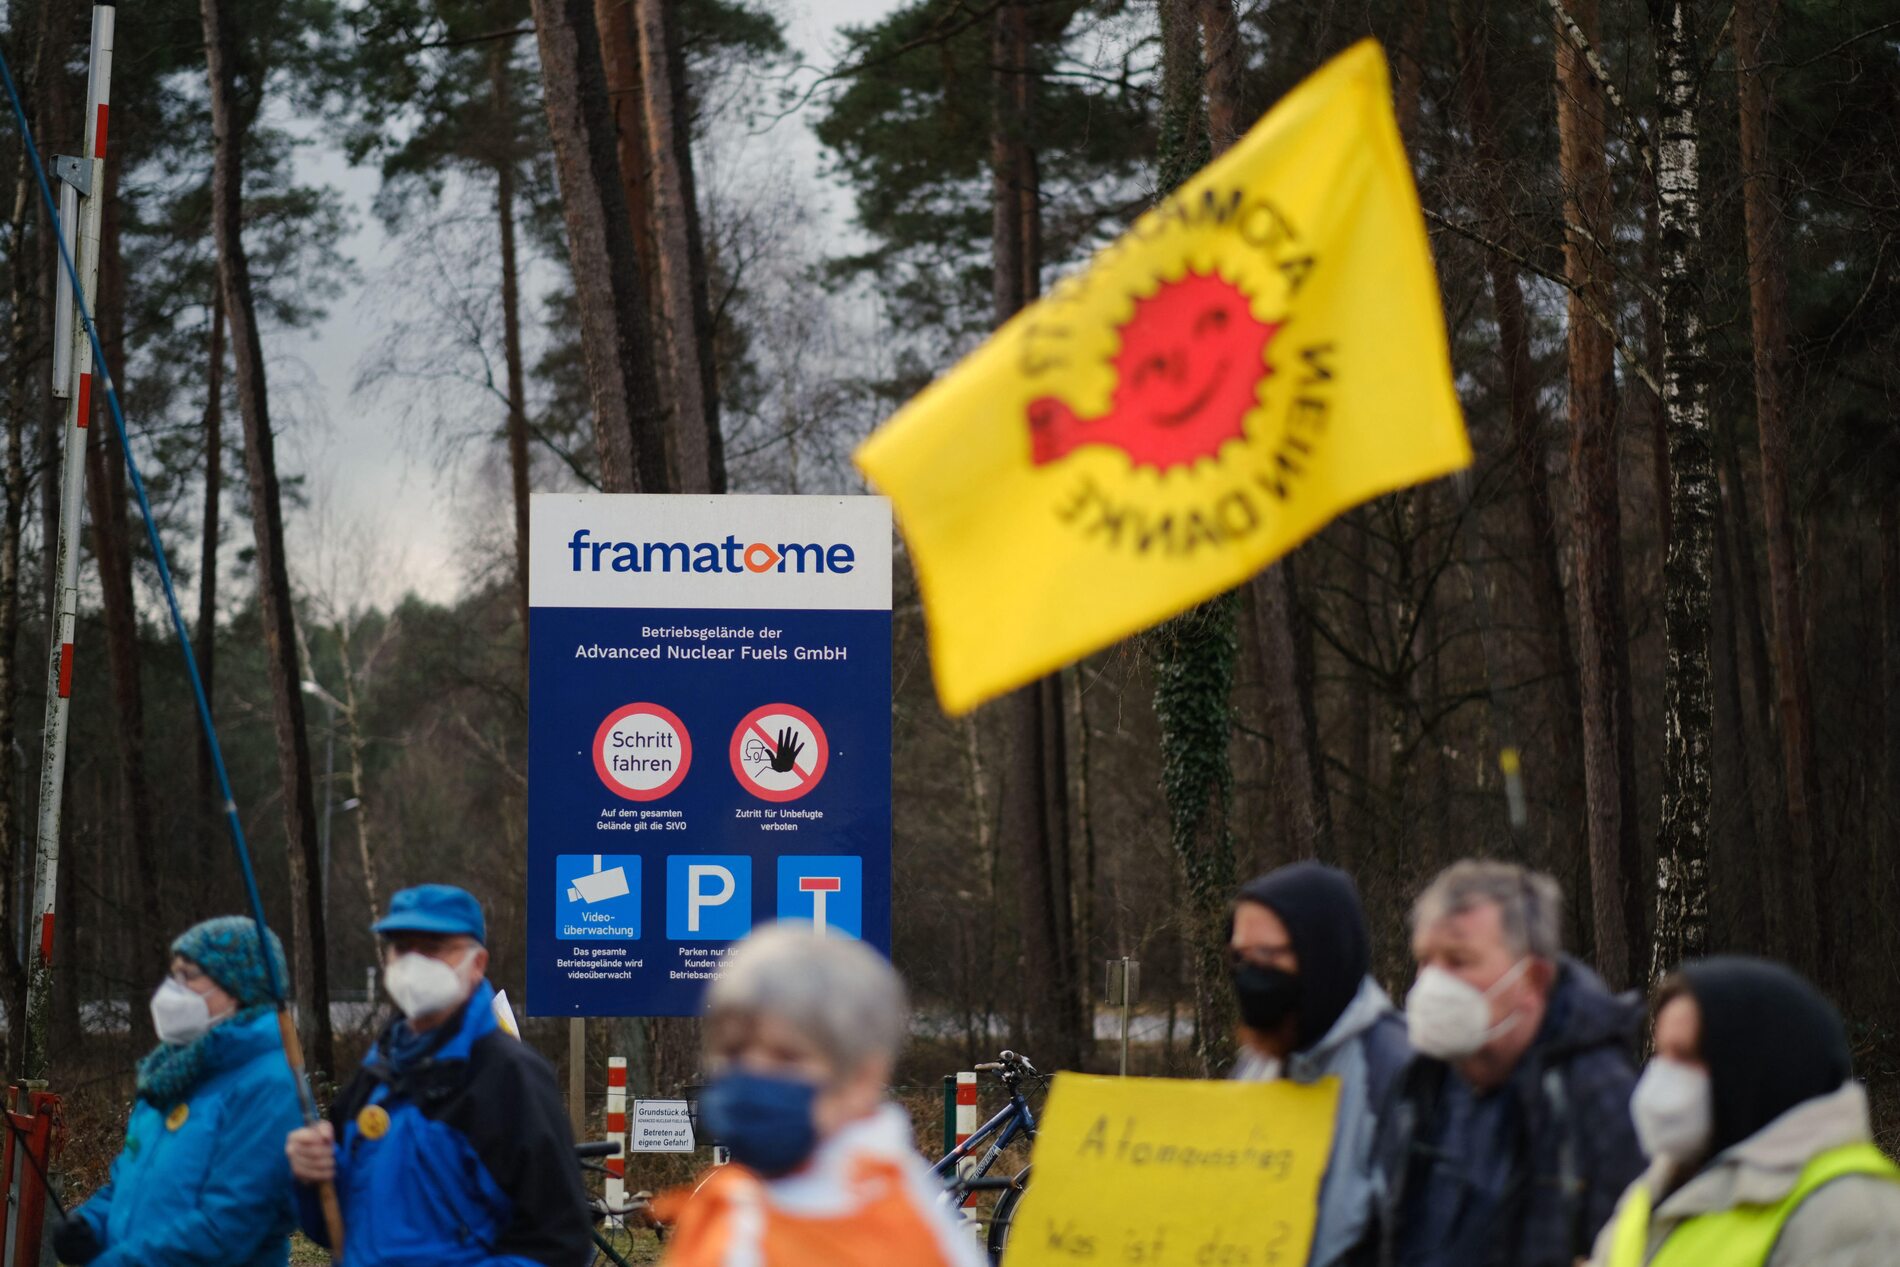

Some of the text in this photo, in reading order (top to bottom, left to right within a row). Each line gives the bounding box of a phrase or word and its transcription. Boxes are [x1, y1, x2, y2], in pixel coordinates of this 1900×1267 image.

[568, 529, 855, 574] framatome
[641, 626, 783, 640] Betriebsgelände der
[575, 644, 848, 660] Advanced Nuclear Fuels GmbH
[612, 731, 673, 748] Schritt
[612, 755, 672, 772] fahren
[601, 808, 683, 819] Auf dem gesamten
[735, 809, 823, 820] Zutritt für Unbefugte
[596, 821, 687, 832] Gelände gilt die StVO
[760, 822, 798, 831] verboten
[688, 865, 735, 931] P
[581, 912, 615, 922] Video-
[563, 925, 634, 937] überwachung
[573, 947, 627, 957] Das gesamte
[679, 947, 708, 956] Parken
[557, 959, 643, 969] Betriebsgelände wird
[684, 959, 716, 967] Kunden
[567, 970, 632, 979] videoüberwacht
[638, 1108, 680, 1116] Grundstück
[643, 1128, 686, 1136] Betreten auf
[638, 1138, 689, 1147] eigene Gefahr!
